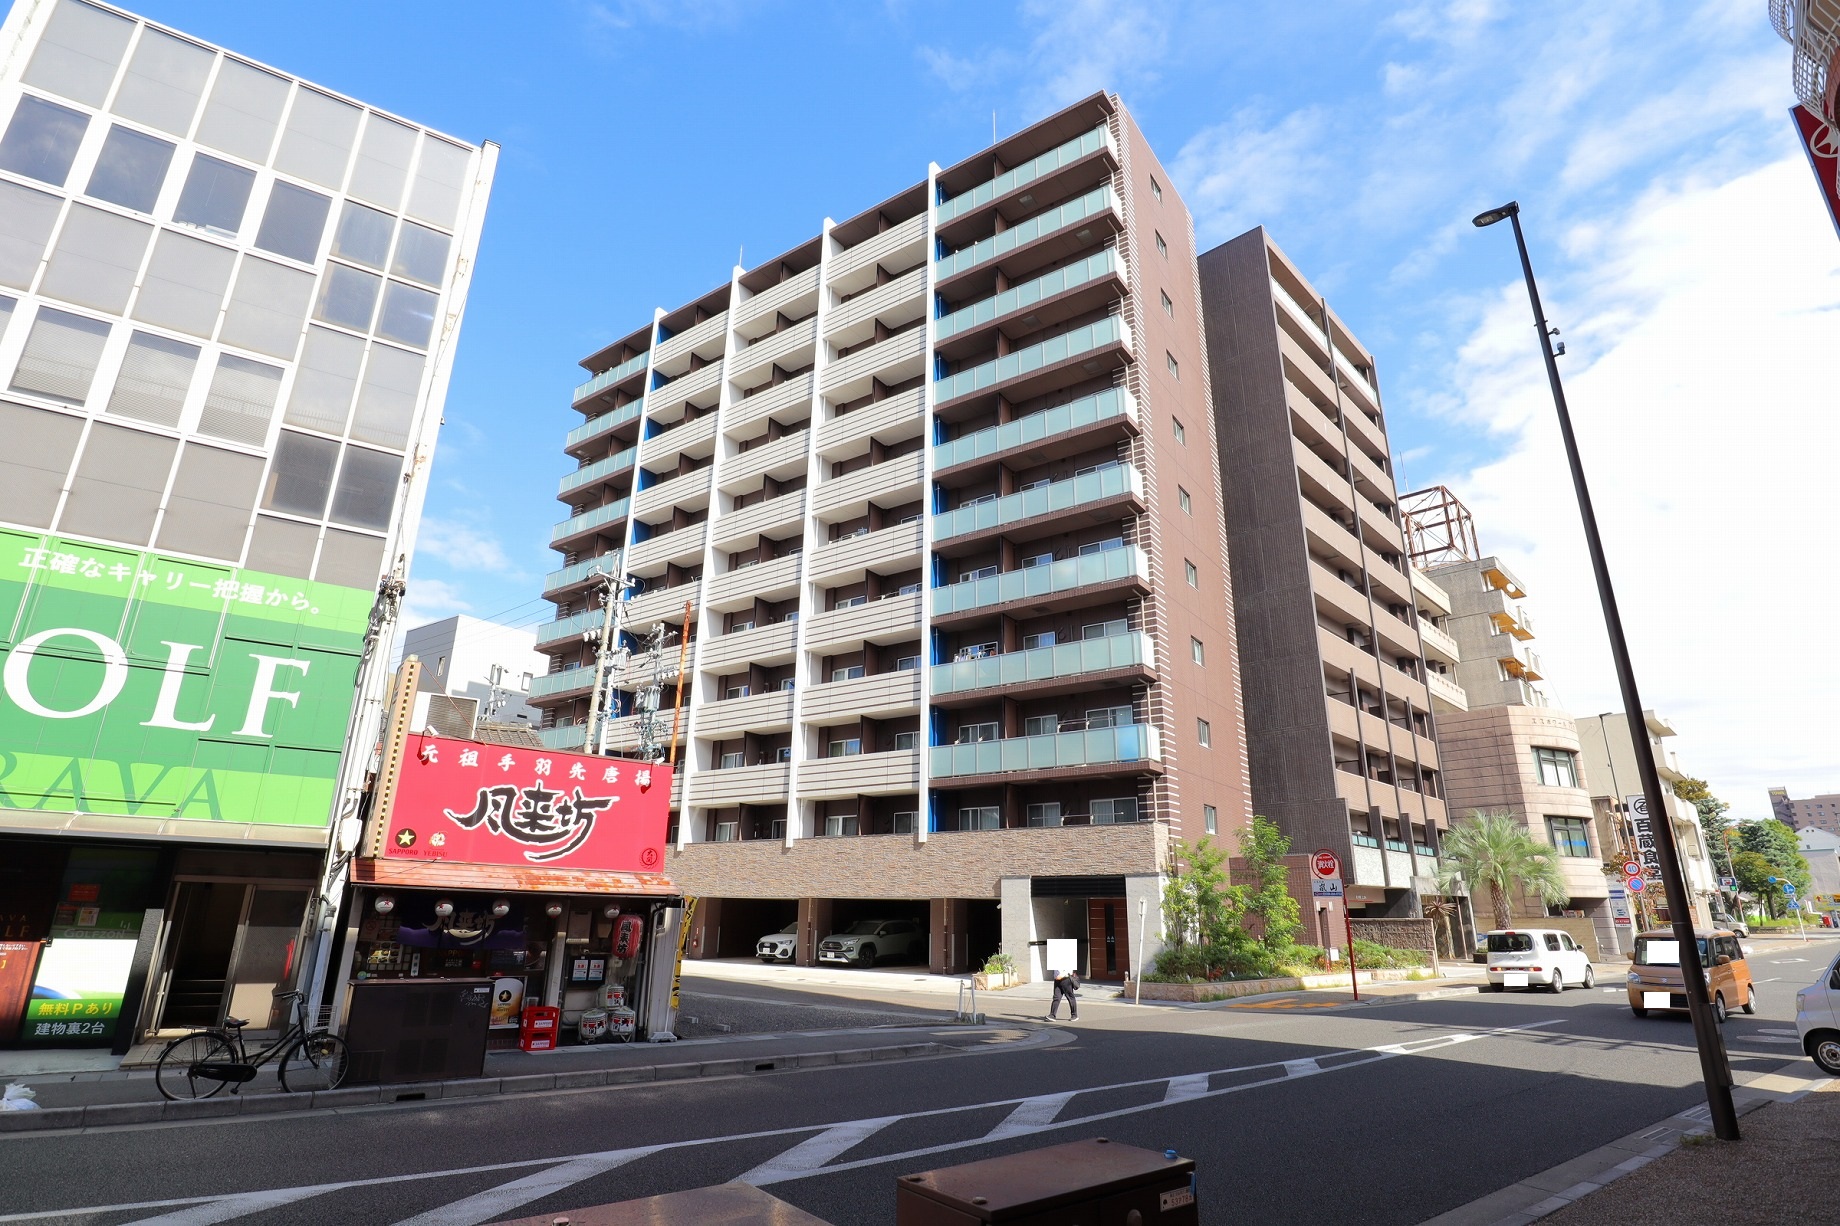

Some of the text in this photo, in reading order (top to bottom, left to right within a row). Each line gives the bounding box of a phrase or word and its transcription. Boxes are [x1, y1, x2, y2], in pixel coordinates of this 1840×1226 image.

[19, 547, 321, 614] 正確なキャリー把握から。
[421, 744, 652, 786] 元祖手羽先唐揚
[444, 779, 620, 862] 風来坊
[388, 848, 418, 856] SAPPORO
[423, 850, 448, 858] YEBISU
[1317, 860, 1334, 869] 消火栓
[1627, 865, 1637, 873] 40
[64, 928, 125, 938] GOLFZON
[617, 920, 632, 954] 風来坊
[38, 1003, 113, 1016] 無料Pあり
[34, 1022, 105, 1036] 建物裏2台
